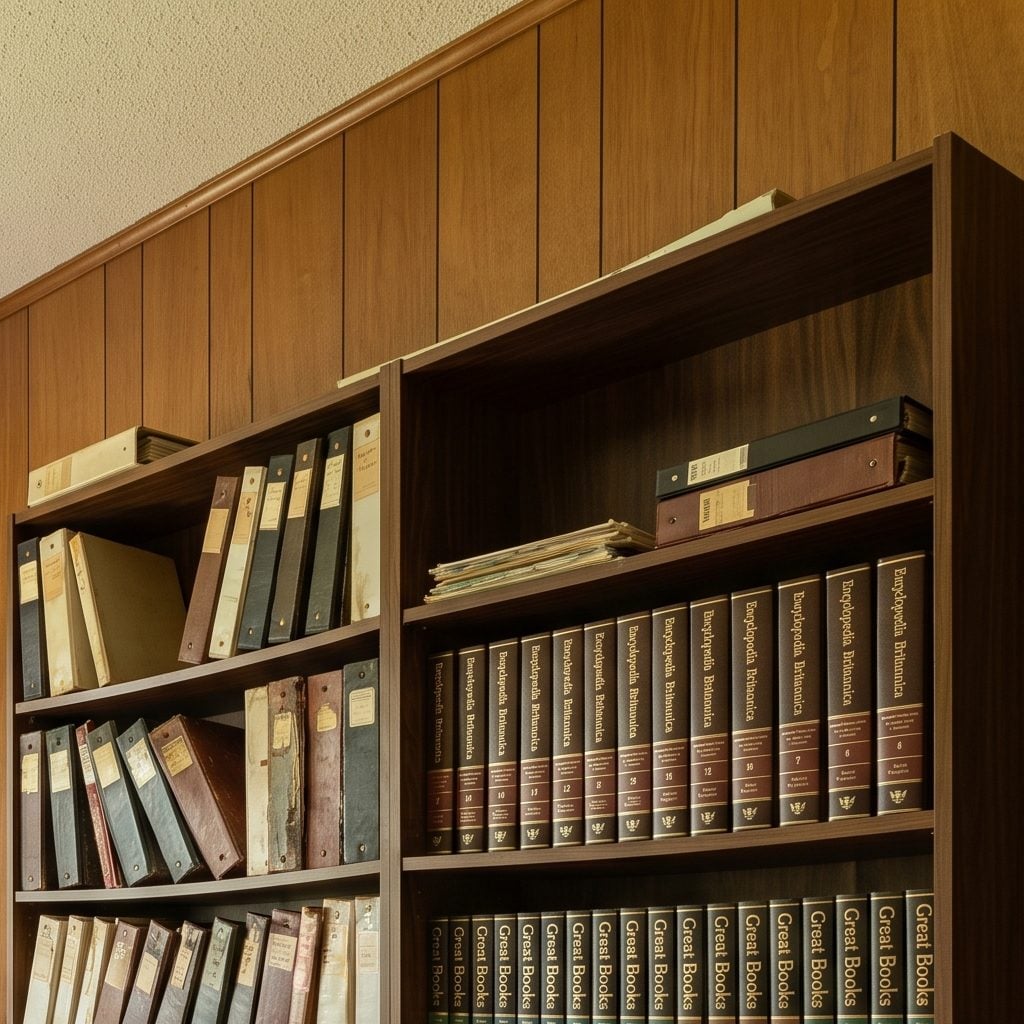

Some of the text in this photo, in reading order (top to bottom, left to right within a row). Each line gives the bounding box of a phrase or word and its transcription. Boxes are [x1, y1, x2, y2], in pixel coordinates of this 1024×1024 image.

[811, 911, 825, 953] Great
[844, 909, 859, 951] Great
[879, 906, 894, 949] Great
[917, 904, 932, 948] Great
[715, 916, 730, 1009] Great Books
[747, 962, 761, 1009] Books
[778, 960, 794, 1008] Books
[811, 959, 828, 1008] Books
[844, 957, 861, 1007] Books
[879, 956, 897, 1007] Books
[917, 955, 934, 1006] Books
[654, 964, 668, 1010] Books
[683, 964, 697, 1010] Books
